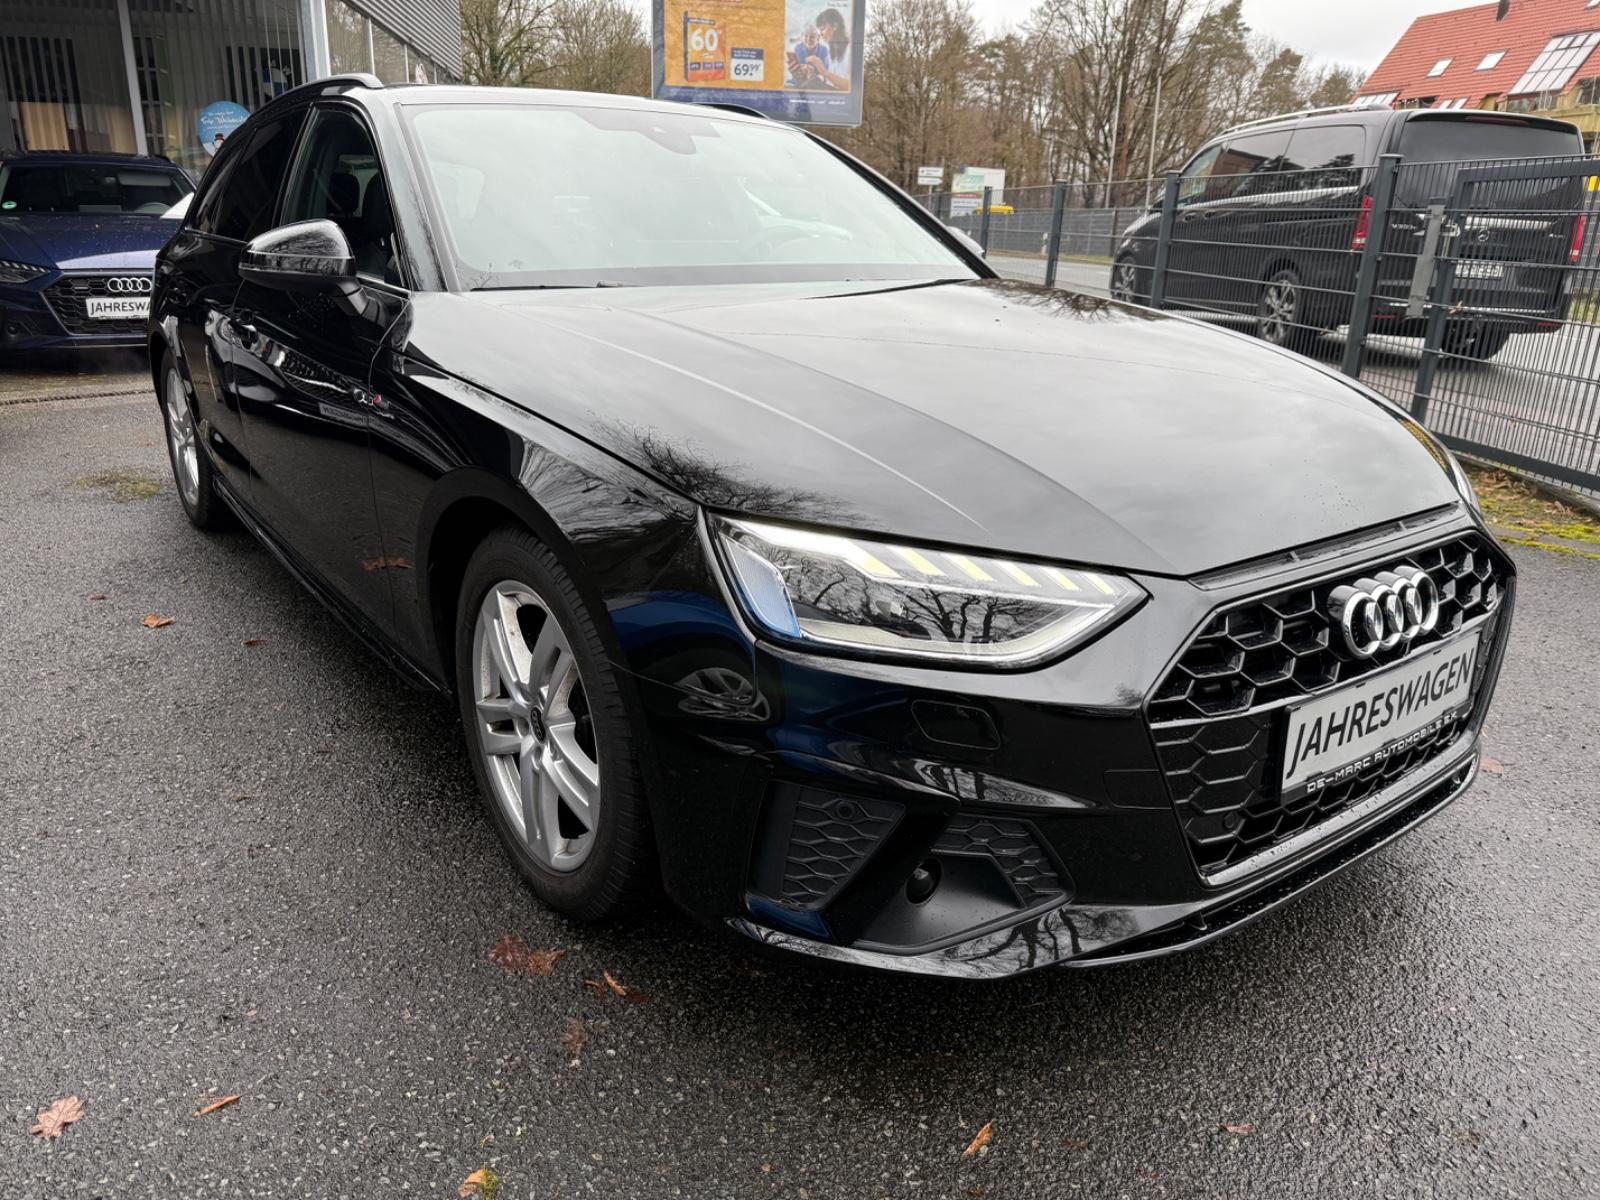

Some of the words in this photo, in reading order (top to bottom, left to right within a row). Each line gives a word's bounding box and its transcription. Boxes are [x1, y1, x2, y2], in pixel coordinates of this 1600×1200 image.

[691, 28, 719, 52] 60
[1286, 647, 1475, 780] JAHRESWAGEN
[1307, 757, 1370, 793] DE-MARC
